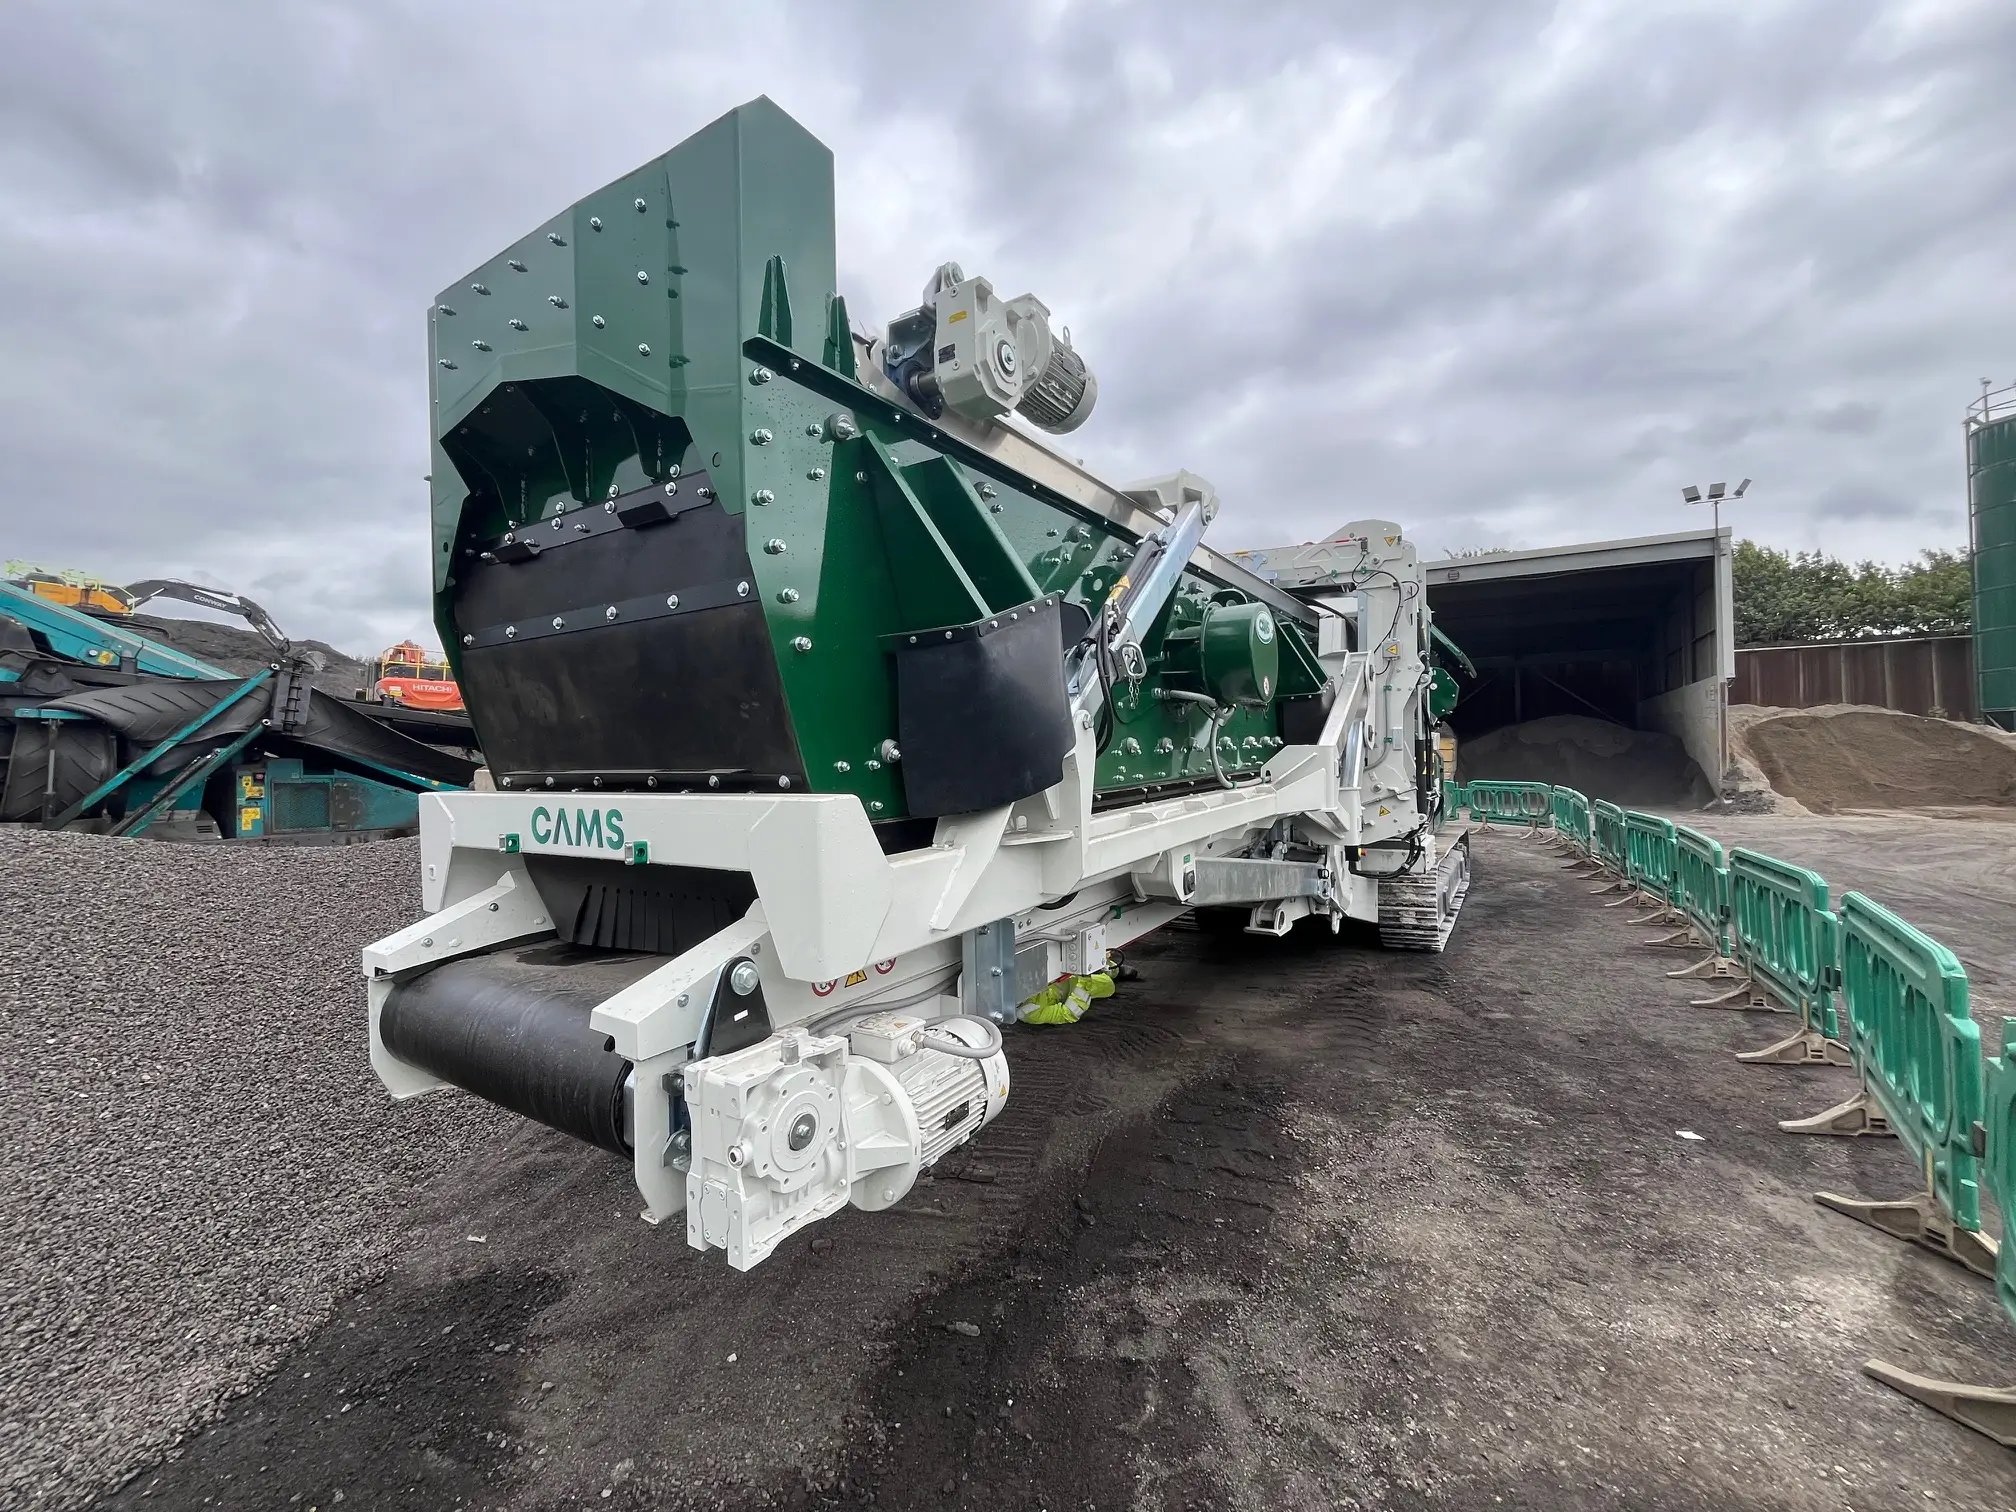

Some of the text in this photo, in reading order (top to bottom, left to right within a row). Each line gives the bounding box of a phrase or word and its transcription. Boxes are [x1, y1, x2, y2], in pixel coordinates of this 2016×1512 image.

[193, 594, 227, 608] CONWAY
[412, 683, 452, 693] HITACHI
[531, 806, 625, 850] CAMS
